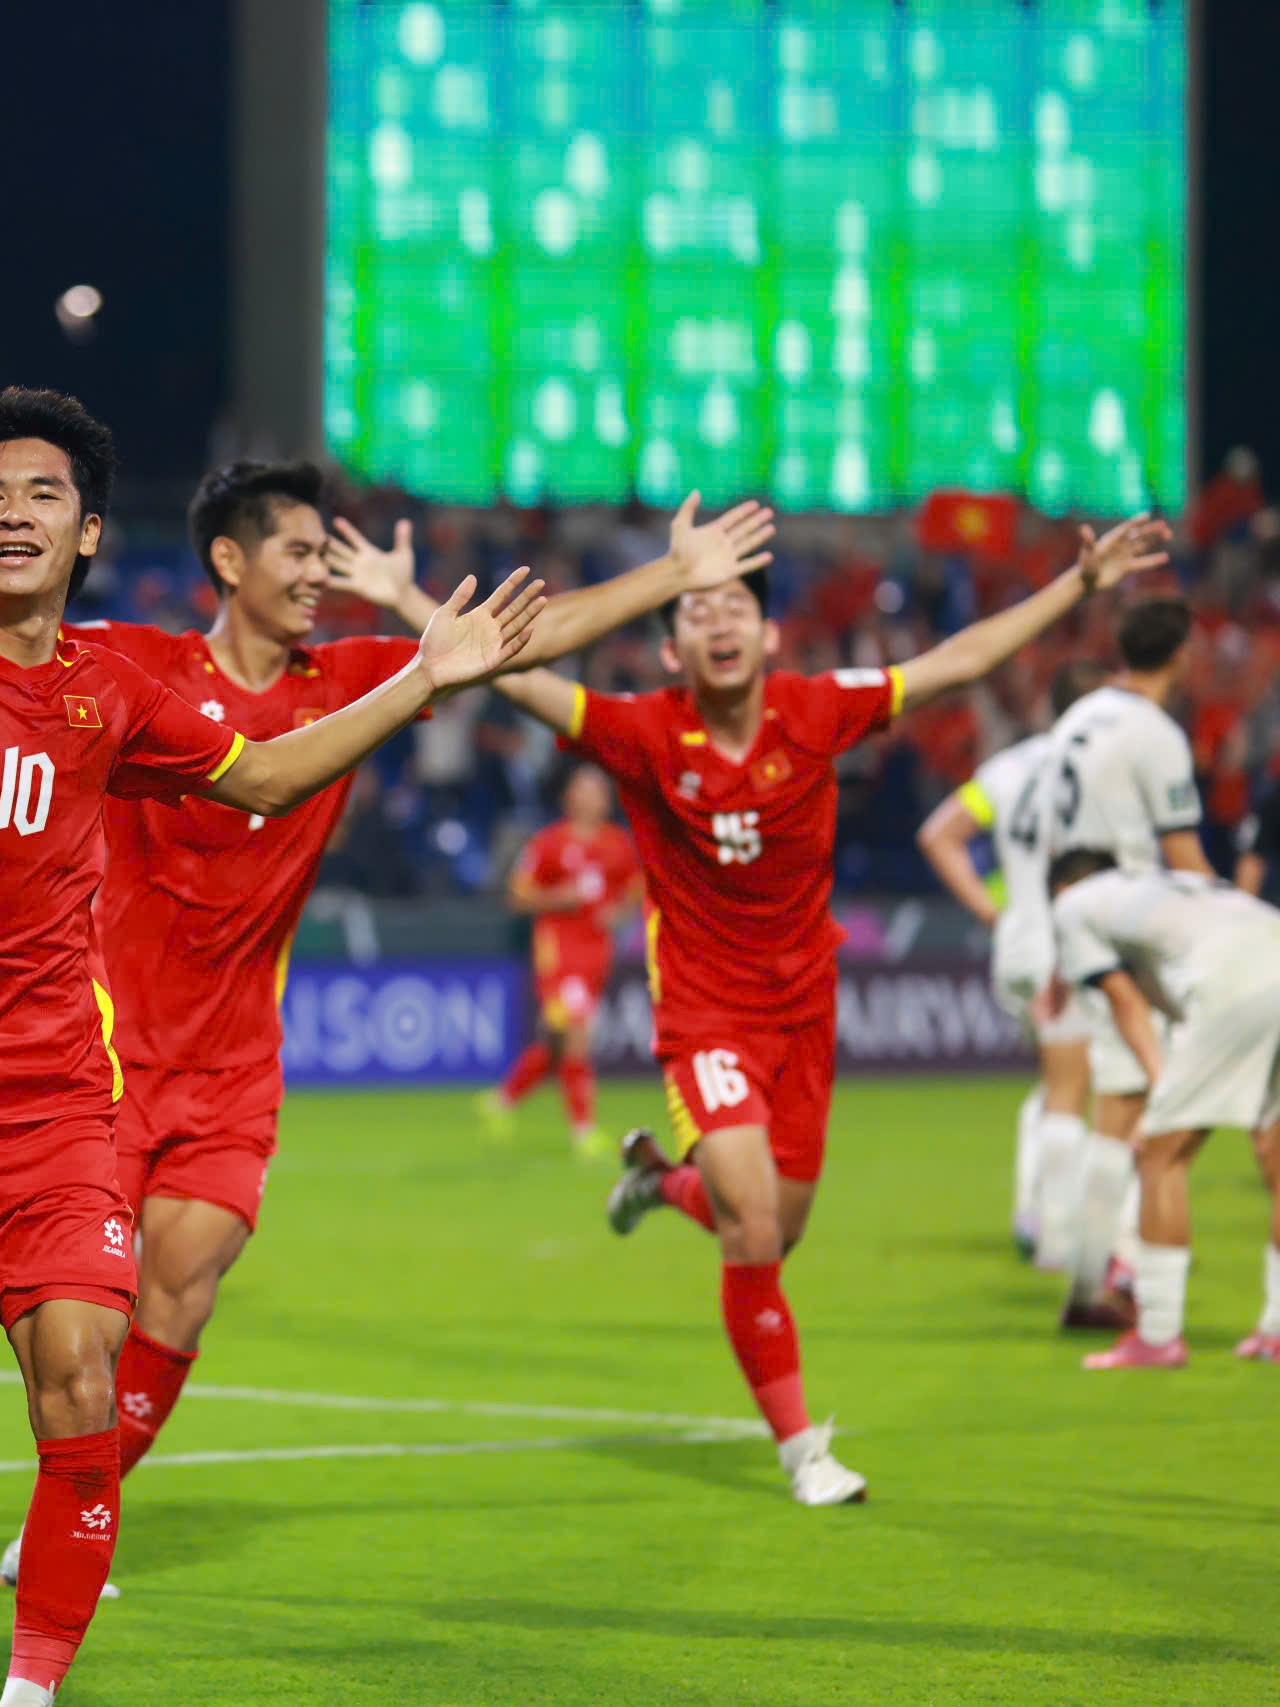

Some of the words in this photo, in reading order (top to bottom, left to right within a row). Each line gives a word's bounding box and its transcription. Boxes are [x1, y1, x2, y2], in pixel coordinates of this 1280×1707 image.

[712, 810, 762, 864] 15
[282, 974, 506, 1072] ISON
[693, 1048, 749, 1113] 16
